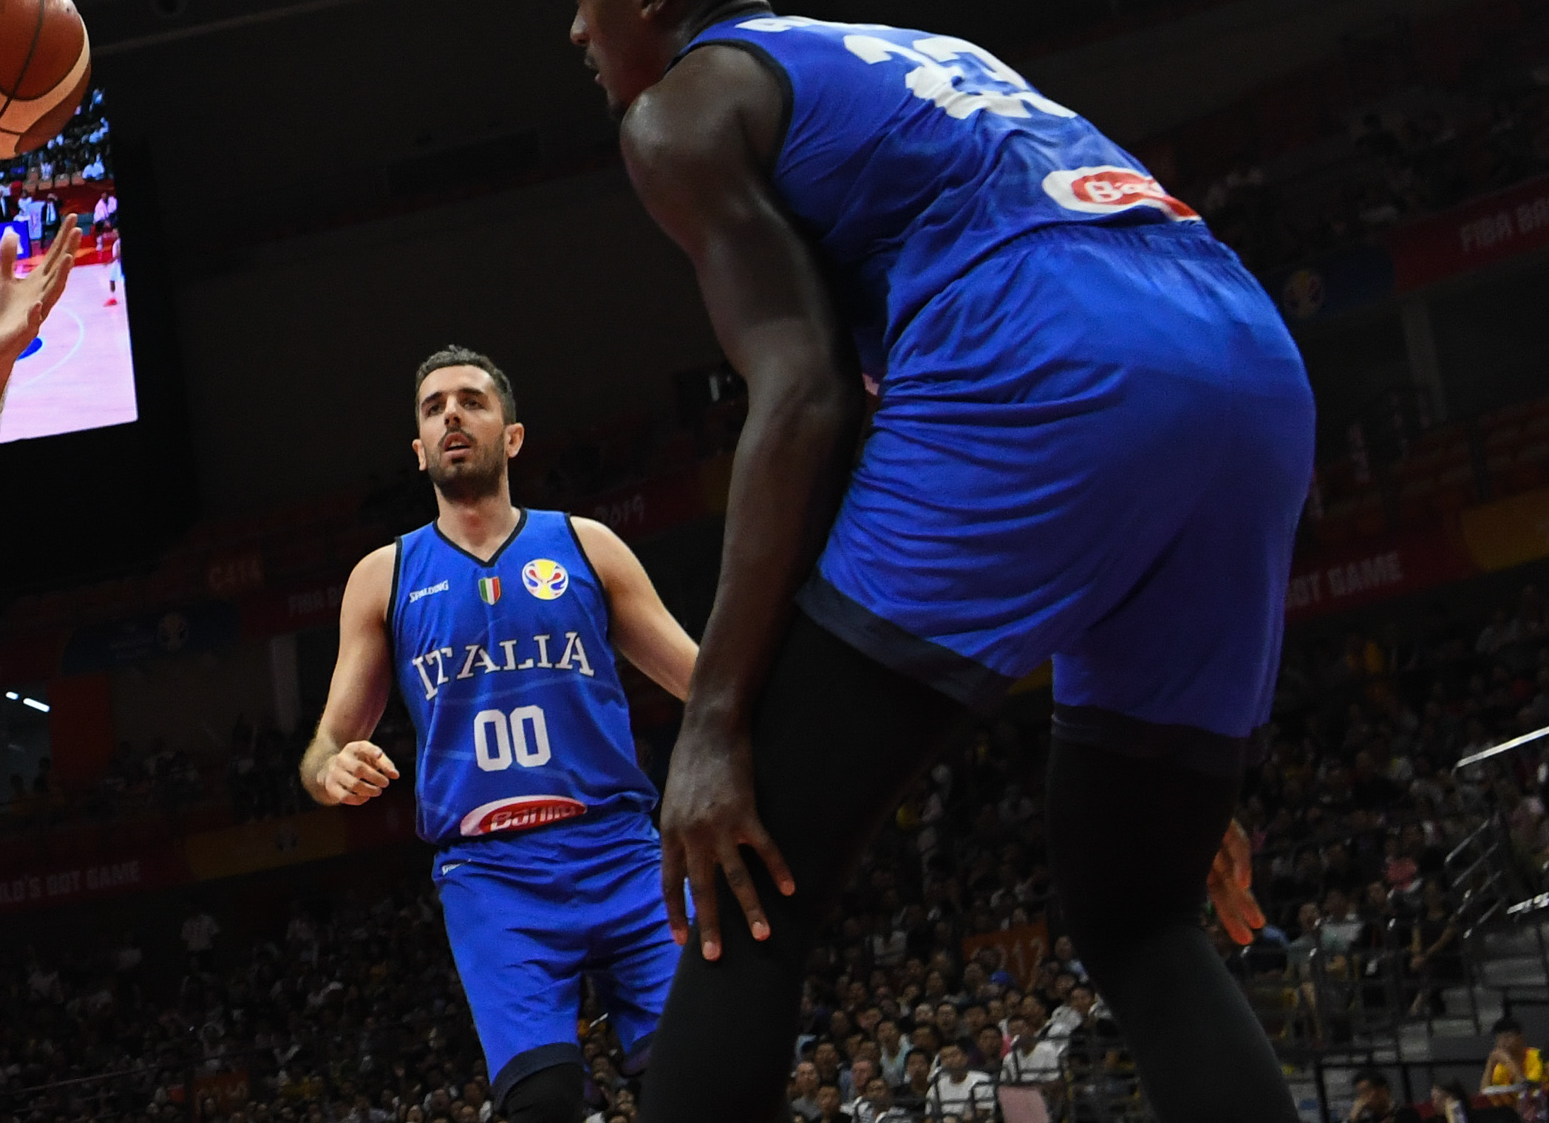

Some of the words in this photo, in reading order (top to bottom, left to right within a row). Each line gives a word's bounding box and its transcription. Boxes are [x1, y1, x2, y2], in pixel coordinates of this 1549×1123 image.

[1459, 213, 1513, 253] FIBA
[1327, 550, 1403, 598] GAME
[412, 630, 596, 703] ITALIA
[474, 704, 552, 773] 00
[86, 860, 141, 891] GAME
